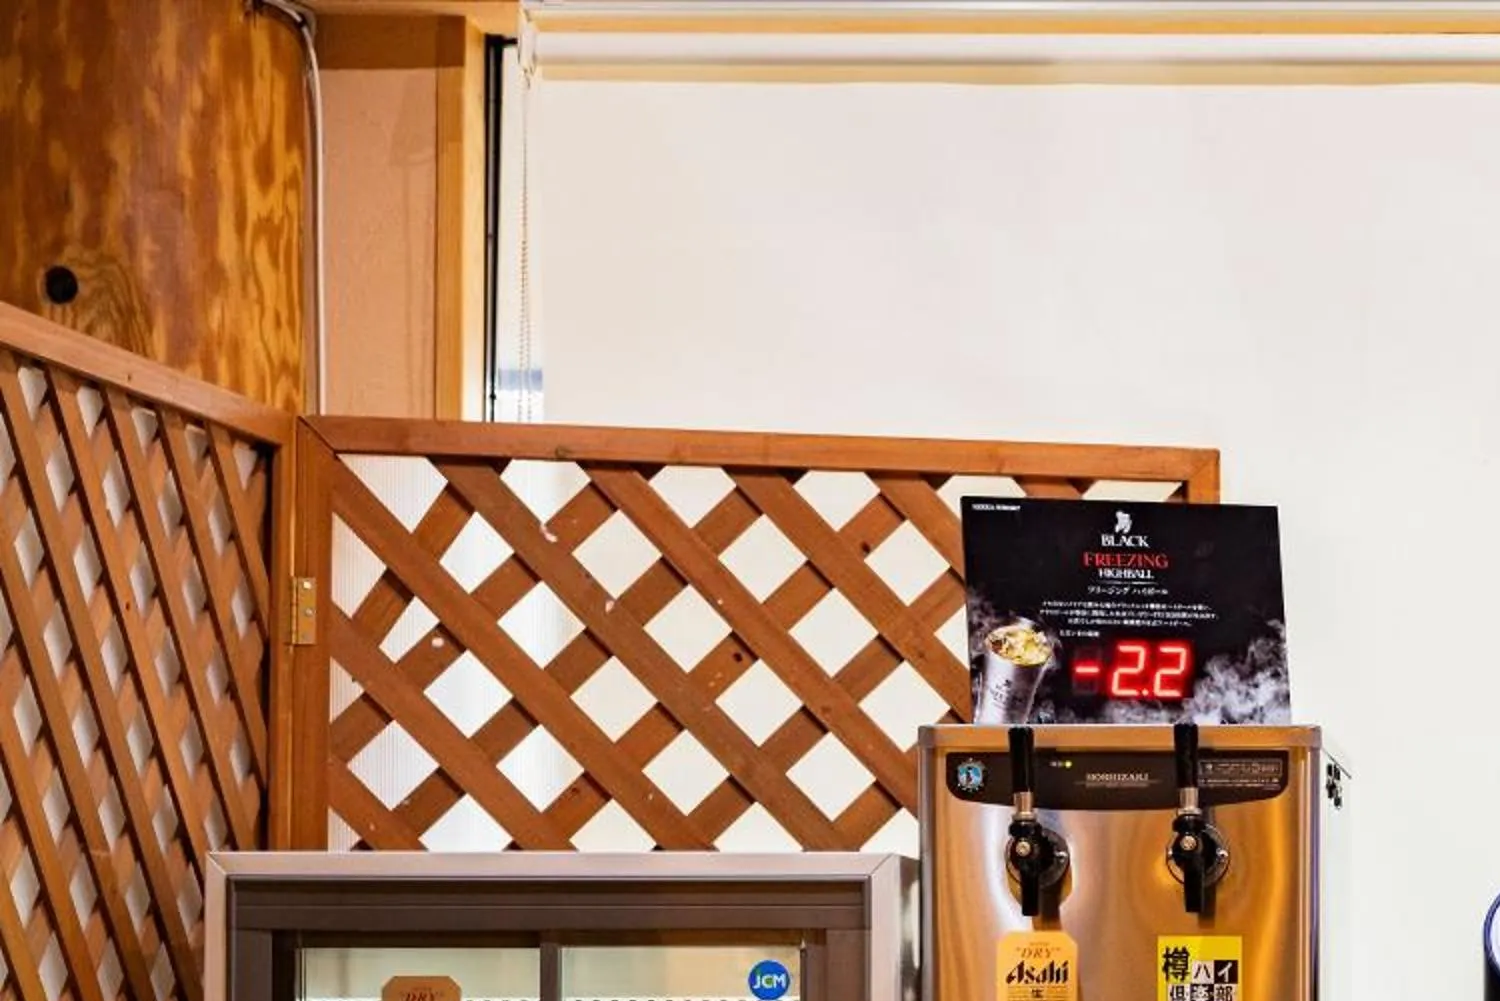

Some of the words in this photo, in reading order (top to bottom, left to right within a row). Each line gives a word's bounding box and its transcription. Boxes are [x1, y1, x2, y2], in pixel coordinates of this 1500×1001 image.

[1101, 534, 1150, 547] BLACK
[1083, 552, 1169, 568] FREEZING
[1098, 568, 1155, 579] HIGHBALL
[1005, 960, 1069, 984] Asahi
[753, 973, 786, 989] JCM
